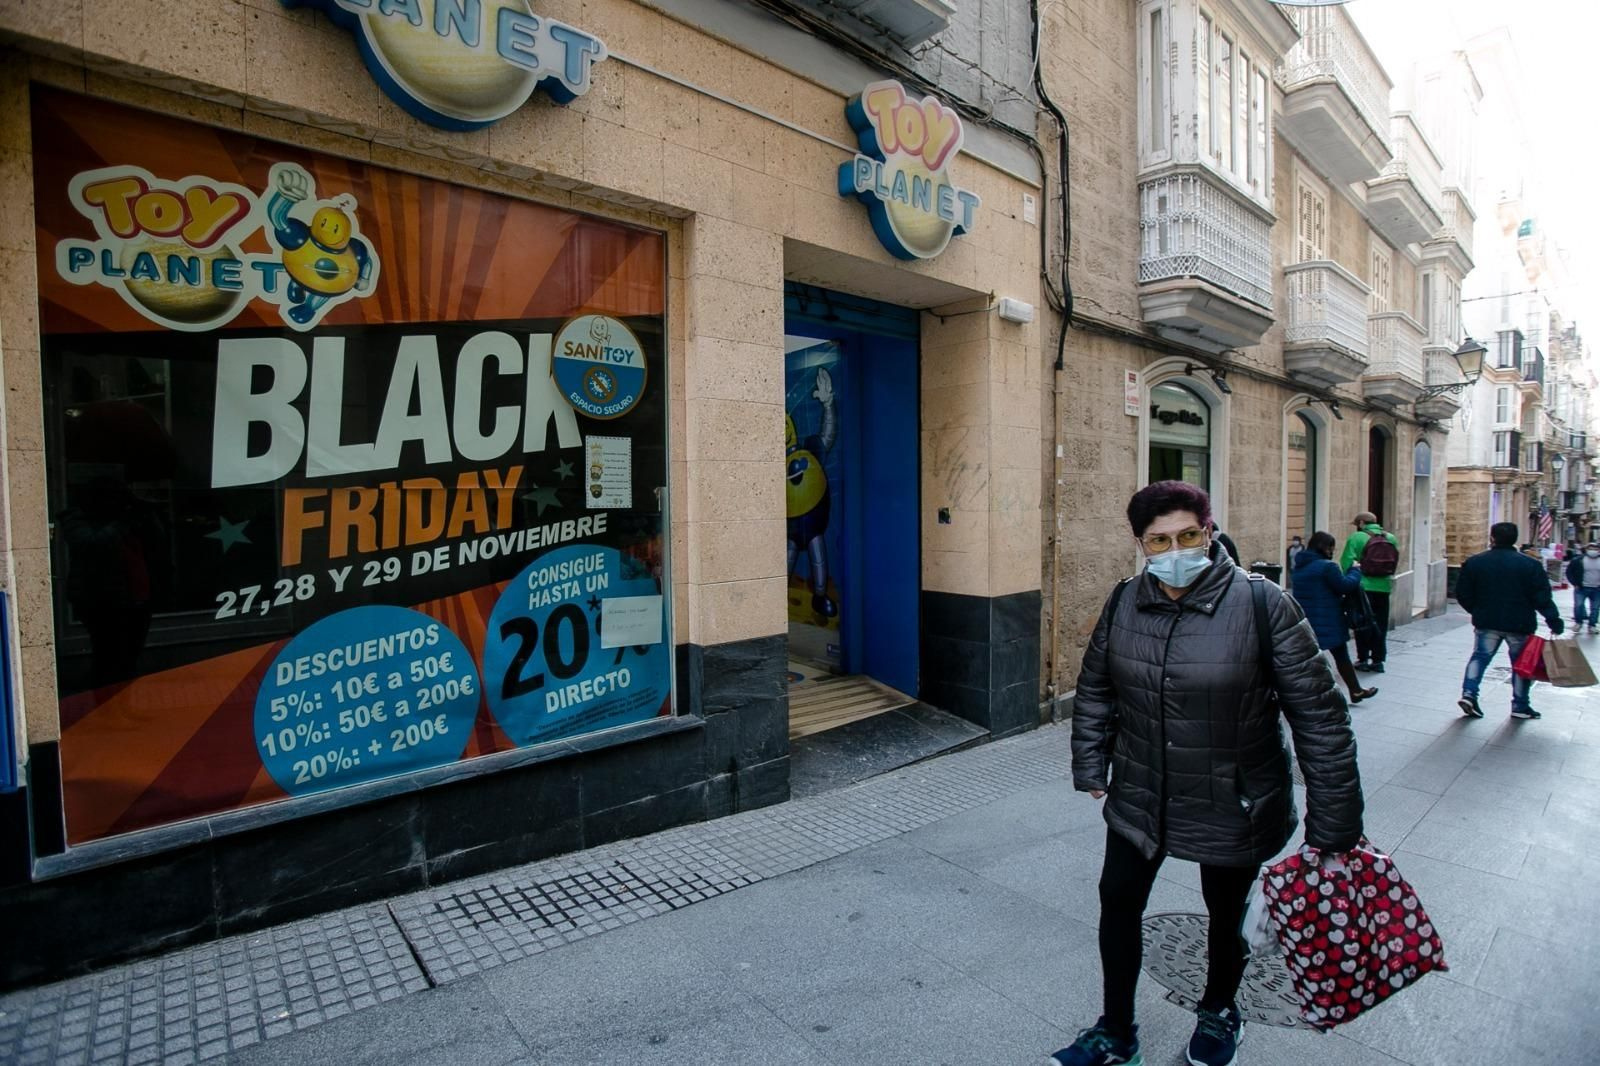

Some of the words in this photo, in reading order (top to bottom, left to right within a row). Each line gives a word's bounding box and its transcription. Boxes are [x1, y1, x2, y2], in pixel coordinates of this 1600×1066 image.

[867, 86, 960, 171] TOY
[83, 175, 251, 248] TOY
[856, 158, 979, 229] PLANET
[67, 246, 286, 294] PLANET
[564, 341, 634, 364] SANITOY
[211, 331, 582, 488] BLACK
[570, 392, 602, 415] ESPACIO
[604, 395, 633, 415] SEGURO
[281, 465, 524, 567] FRIDAY
[214, 575, 315, 619] 27,28
[329, 566, 352, 593] Y
[362, 557, 400, 587] 29
[411, 551, 450, 577] DE
[458, 513, 607, 566] NOVIEMBRE
[527, 553, 605, 590] CONSIGUE
[528, 580, 581, 610] HASTA
[586, 572, 608, 593] UN
[271, 690, 322, 722] 5%:
[331, 673, 380, 703] 10€
[387, 672, 403, 689] a
[410, 652, 454, 682] 50€
[276, 624, 440, 686] DESCUENTOS
[262, 720, 331, 757] 10%:
[339, 701, 387, 734] 50€
[395, 700, 410, 717] a
[416, 675, 474, 710] 200€
[546, 668, 630, 713] DIRECTO
[292, 747, 360, 784] 20%:
[368, 739, 382, 756] +
[390, 714, 449, 752] 200€
